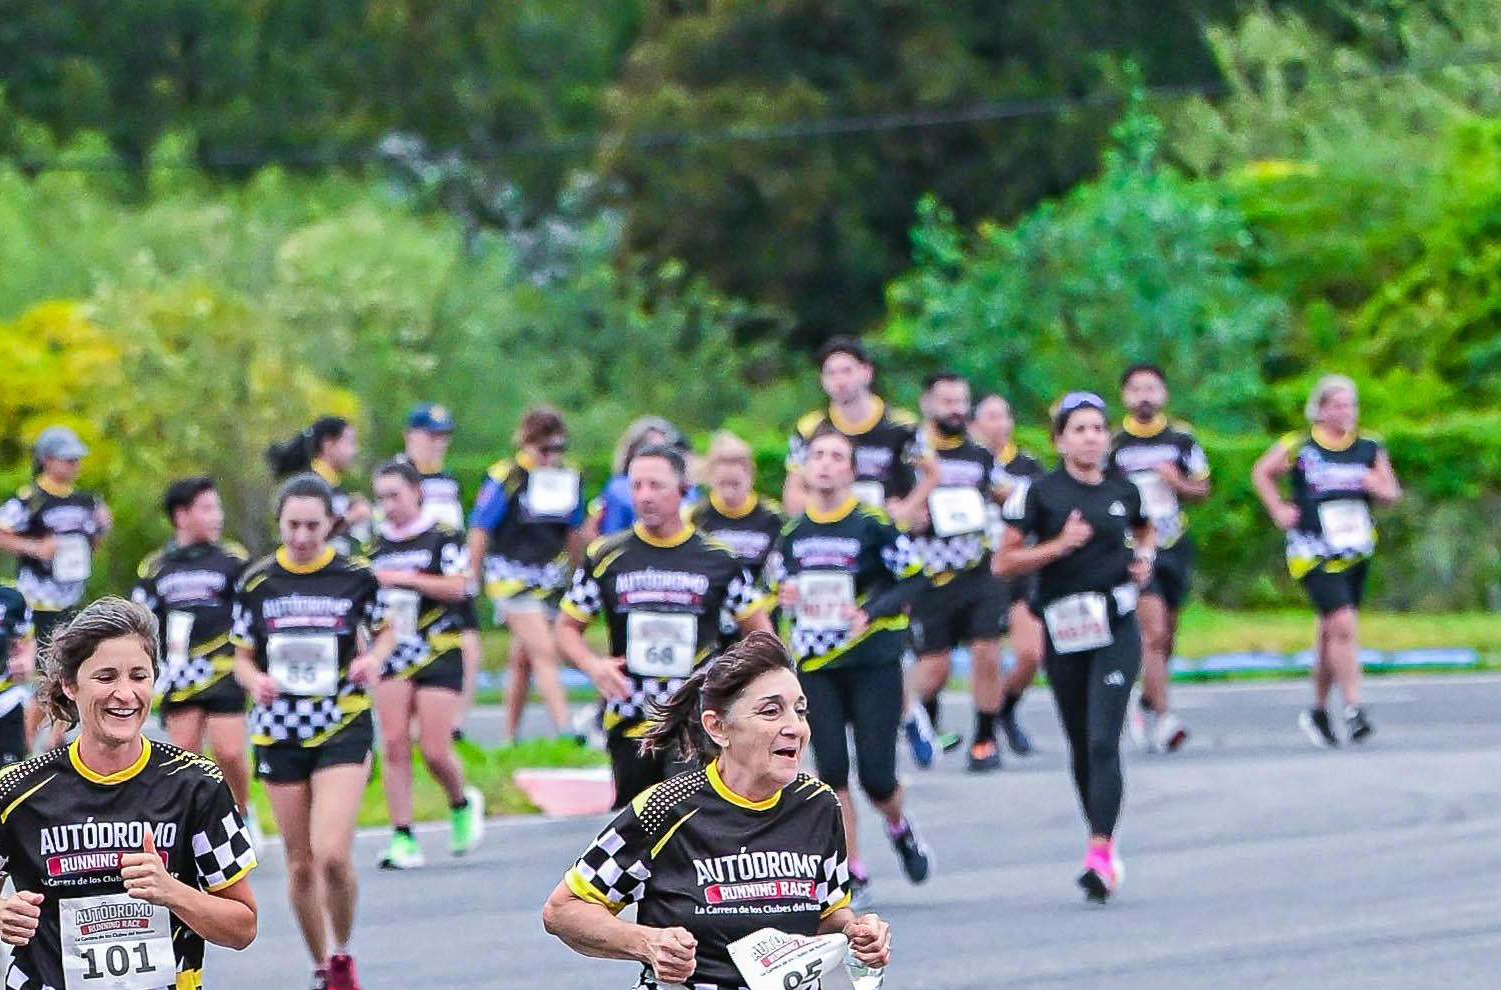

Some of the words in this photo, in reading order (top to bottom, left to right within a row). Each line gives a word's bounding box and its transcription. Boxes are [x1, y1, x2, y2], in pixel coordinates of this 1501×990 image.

[40, 816, 177, 856] AUTÓDROMO
[59, 852, 119, 873] RUNNING
[77, 876, 88, 885] de
[89, 876, 102, 885] los
[103, 875, 122, 883] Club
[719, 881, 778, 901] RUNNING
[780, 881, 812, 898] RACE
[76, 901, 154, 925] AUTÓDROMO
[694, 905, 705, 914] La
[706, 905, 737, 914] Carrera
[738, 905, 750, 914] de
[750, 905, 763, 914] los
[763, 904, 791, 914] Clubes
[792, 903, 805, 912] del
[122, 920, 141, 929] RACE
[81, 942, 156, 979] 101
